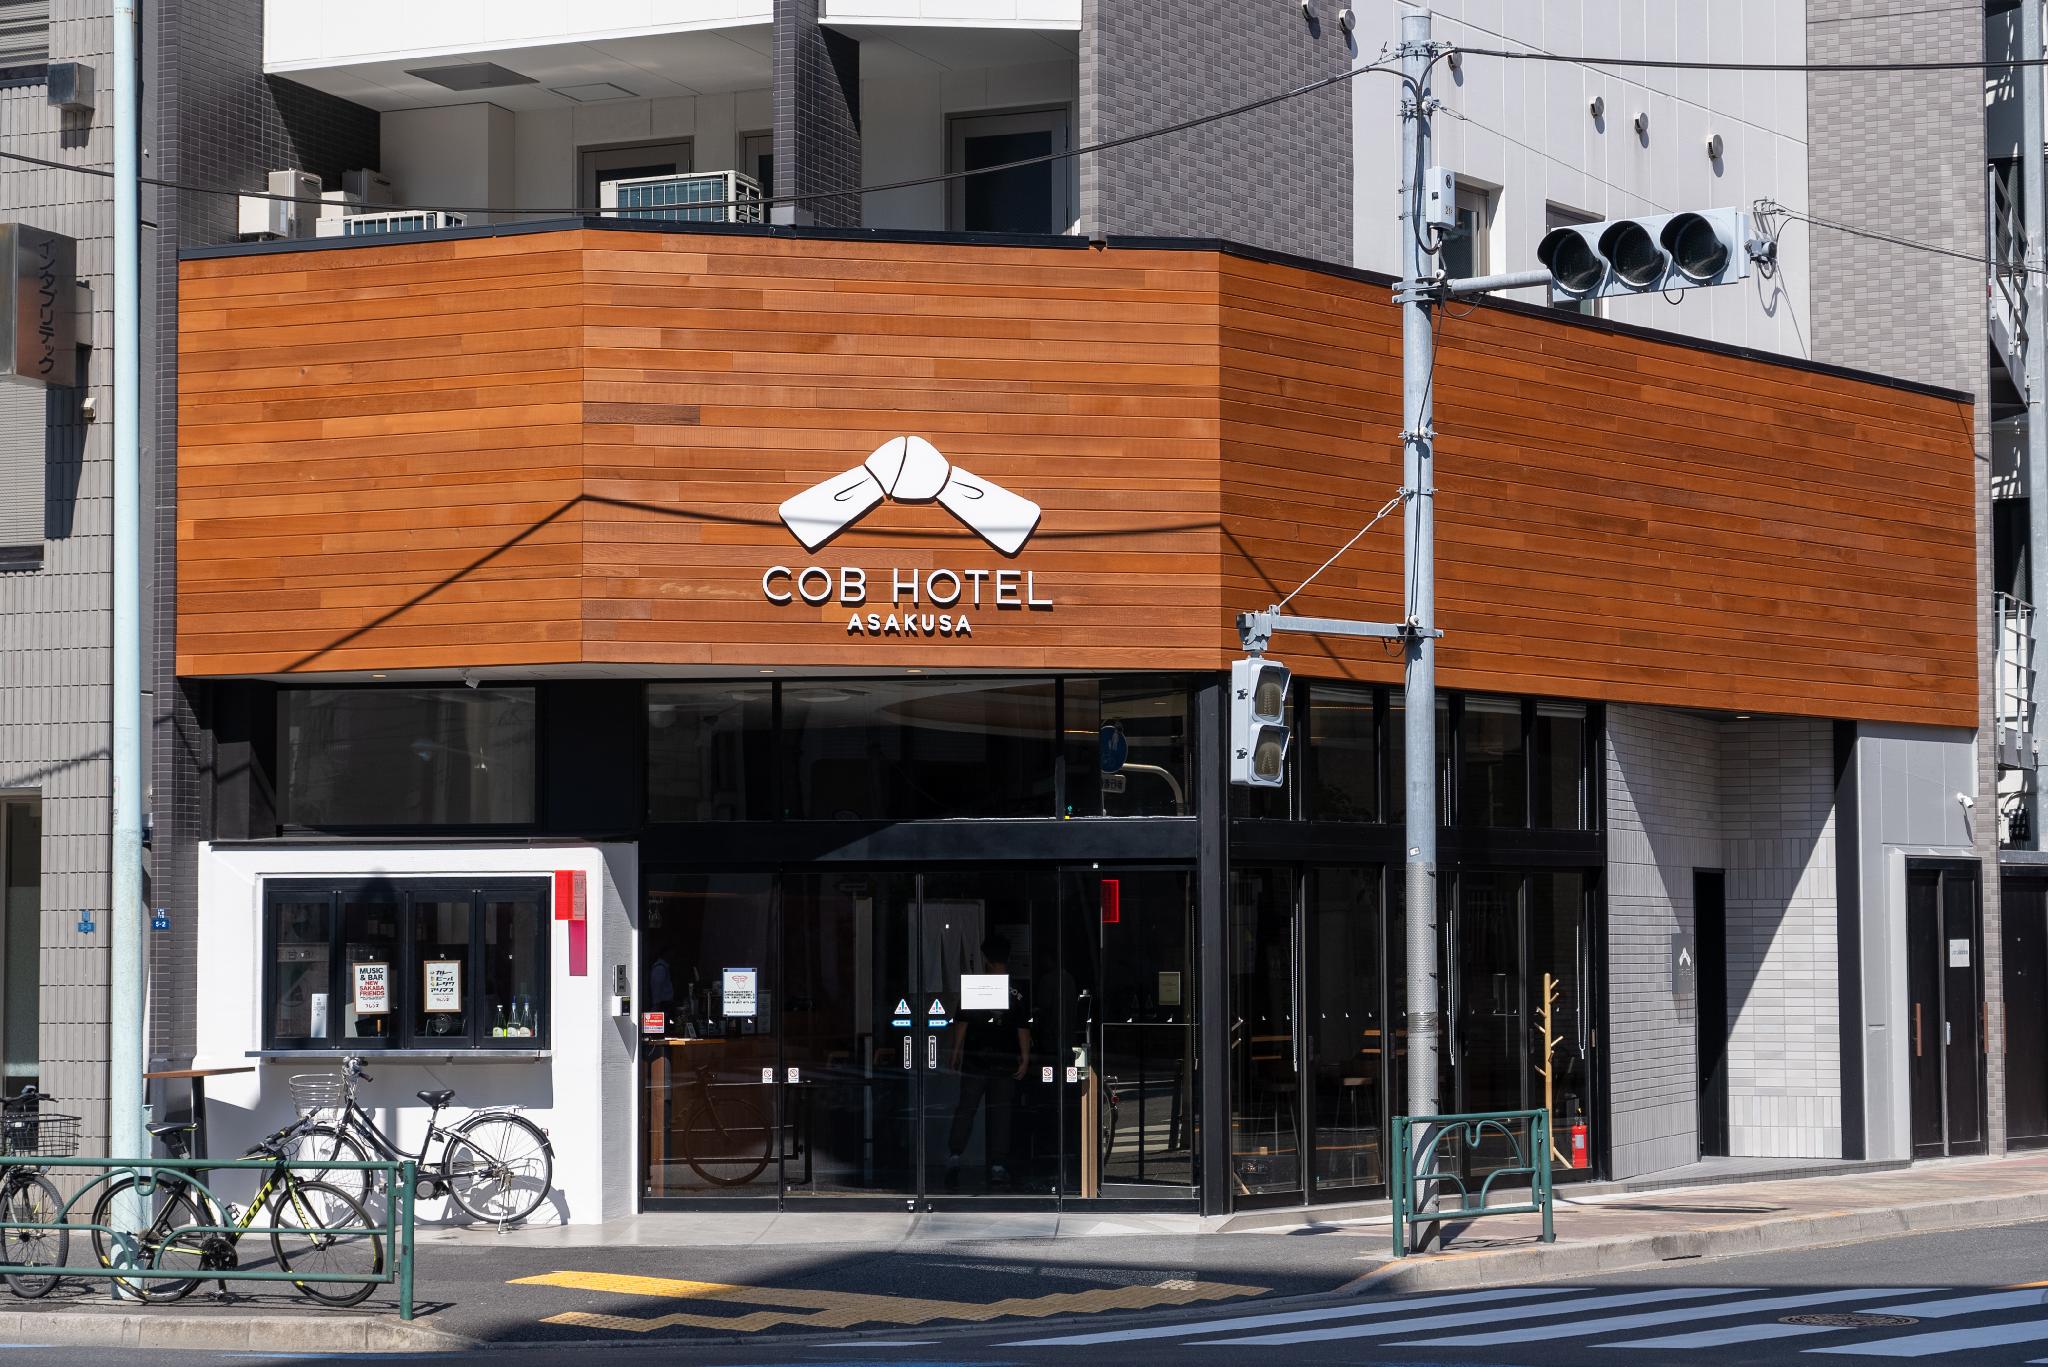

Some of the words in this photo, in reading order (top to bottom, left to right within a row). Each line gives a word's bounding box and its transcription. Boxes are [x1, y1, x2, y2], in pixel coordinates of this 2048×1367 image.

[762, 565, 867, 604] COB
[892, 567, 1054, 606] HOTEL
[847, 612, 973, 634] ASAKUSA
[359, 967, 384, 975] MUSIC
